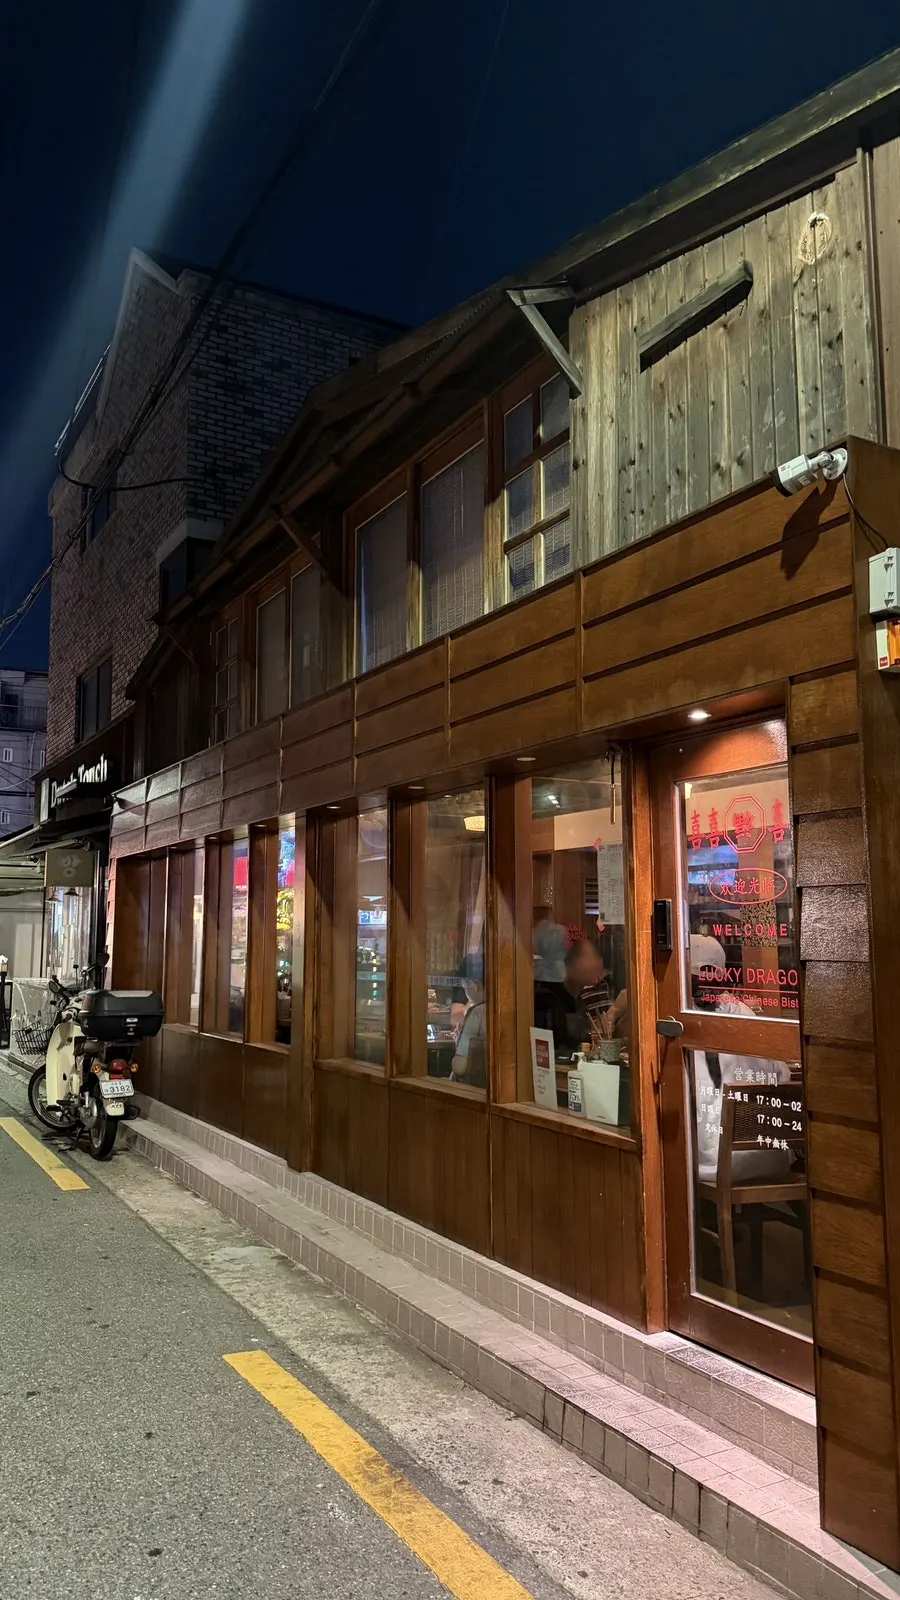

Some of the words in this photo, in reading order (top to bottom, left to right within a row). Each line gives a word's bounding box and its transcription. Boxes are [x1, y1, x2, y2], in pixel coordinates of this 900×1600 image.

[719, 877, 775, 896] 欢迎光临
[713, 923, 788, 936] WELCOME
[698, 967, 742, 982] LUCKY
[746, 968, 798, 986] DRAGO
[701, 992, 740, 1004] Japanese
[742, 994, 779, 1007] Chinese
